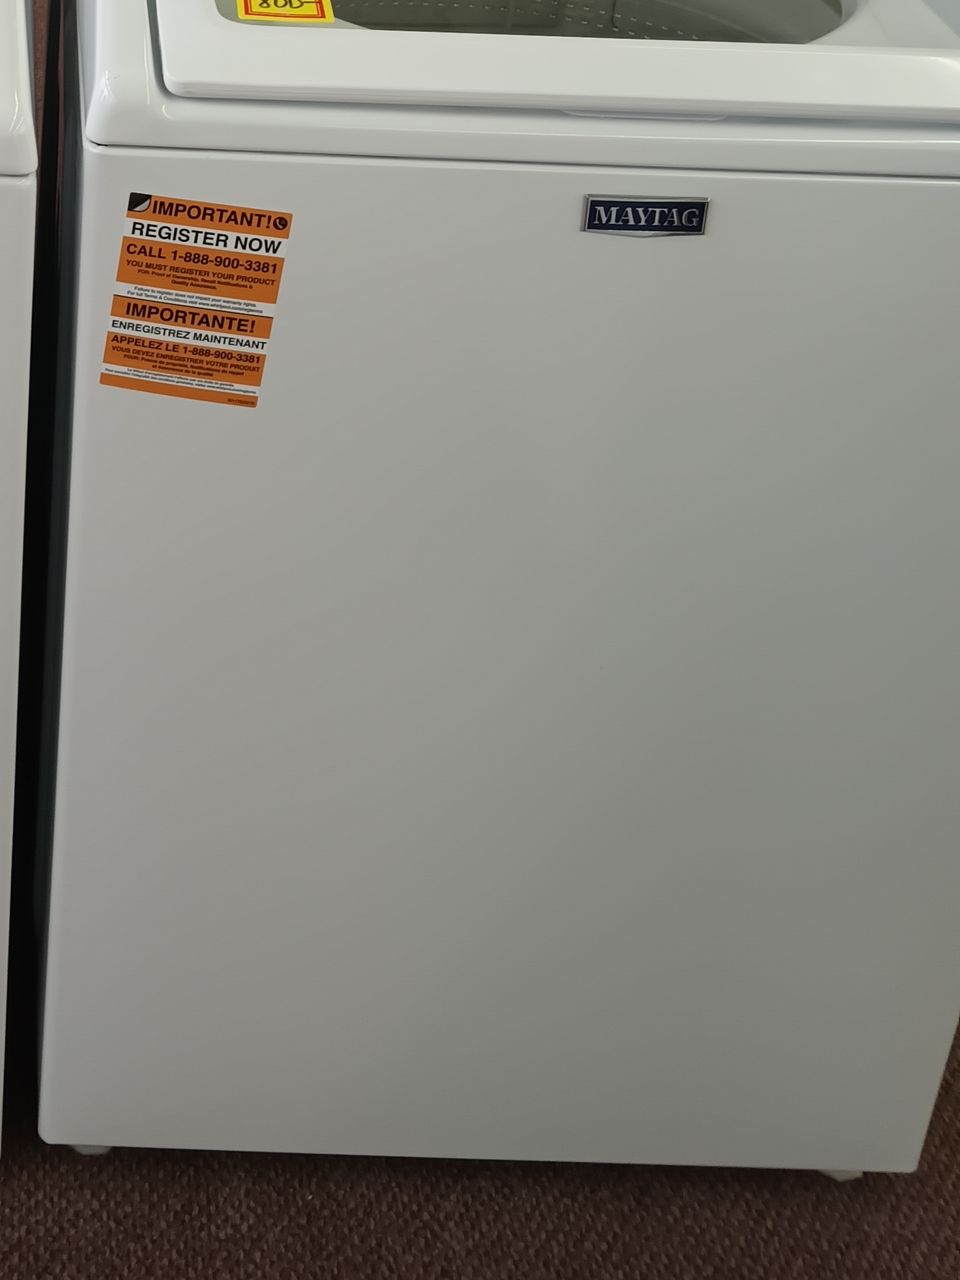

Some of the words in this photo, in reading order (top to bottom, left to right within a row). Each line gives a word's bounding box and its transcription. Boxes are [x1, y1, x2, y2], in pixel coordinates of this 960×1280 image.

[152, 200, 271, 229] IMPORTANT!
[593, 206, 700, 227] MAYTAG
[131, 222, 229, 248] REGISTER
[234, 236, 282, 254] NOW
[126, 243, 166, 259] CALL
[172, 250, 277, 274] 1-888-900-3381
[126, 259, 144, 268] YOU
[145, 262, 167, 271] MUST
[169, 265, 209, 277] REGISTER
[211, 271, 234, 281] YOUR
[236, 275, 276, 286] PRODUCT
[125, 302, 256, 333] IMPORTANTE!
[111, 320, 190, 339] ENREGISTREZ
[193, 333, 267, 350] MAINTENANT
[111, 334, 163, 351] APPELEZ
[165, 342, 179, 353] LE
[182, 346, 260, 363] 1-888-900-3381
[112, 346, 131, 354] VOUS
[132, 348, 154, 358] DEVEZ
[156, 352, 204, 364] ENREGISTRER
[206, 359, 228, 368] VOTRE
[230, 363, 261, 372] PRODUIT
